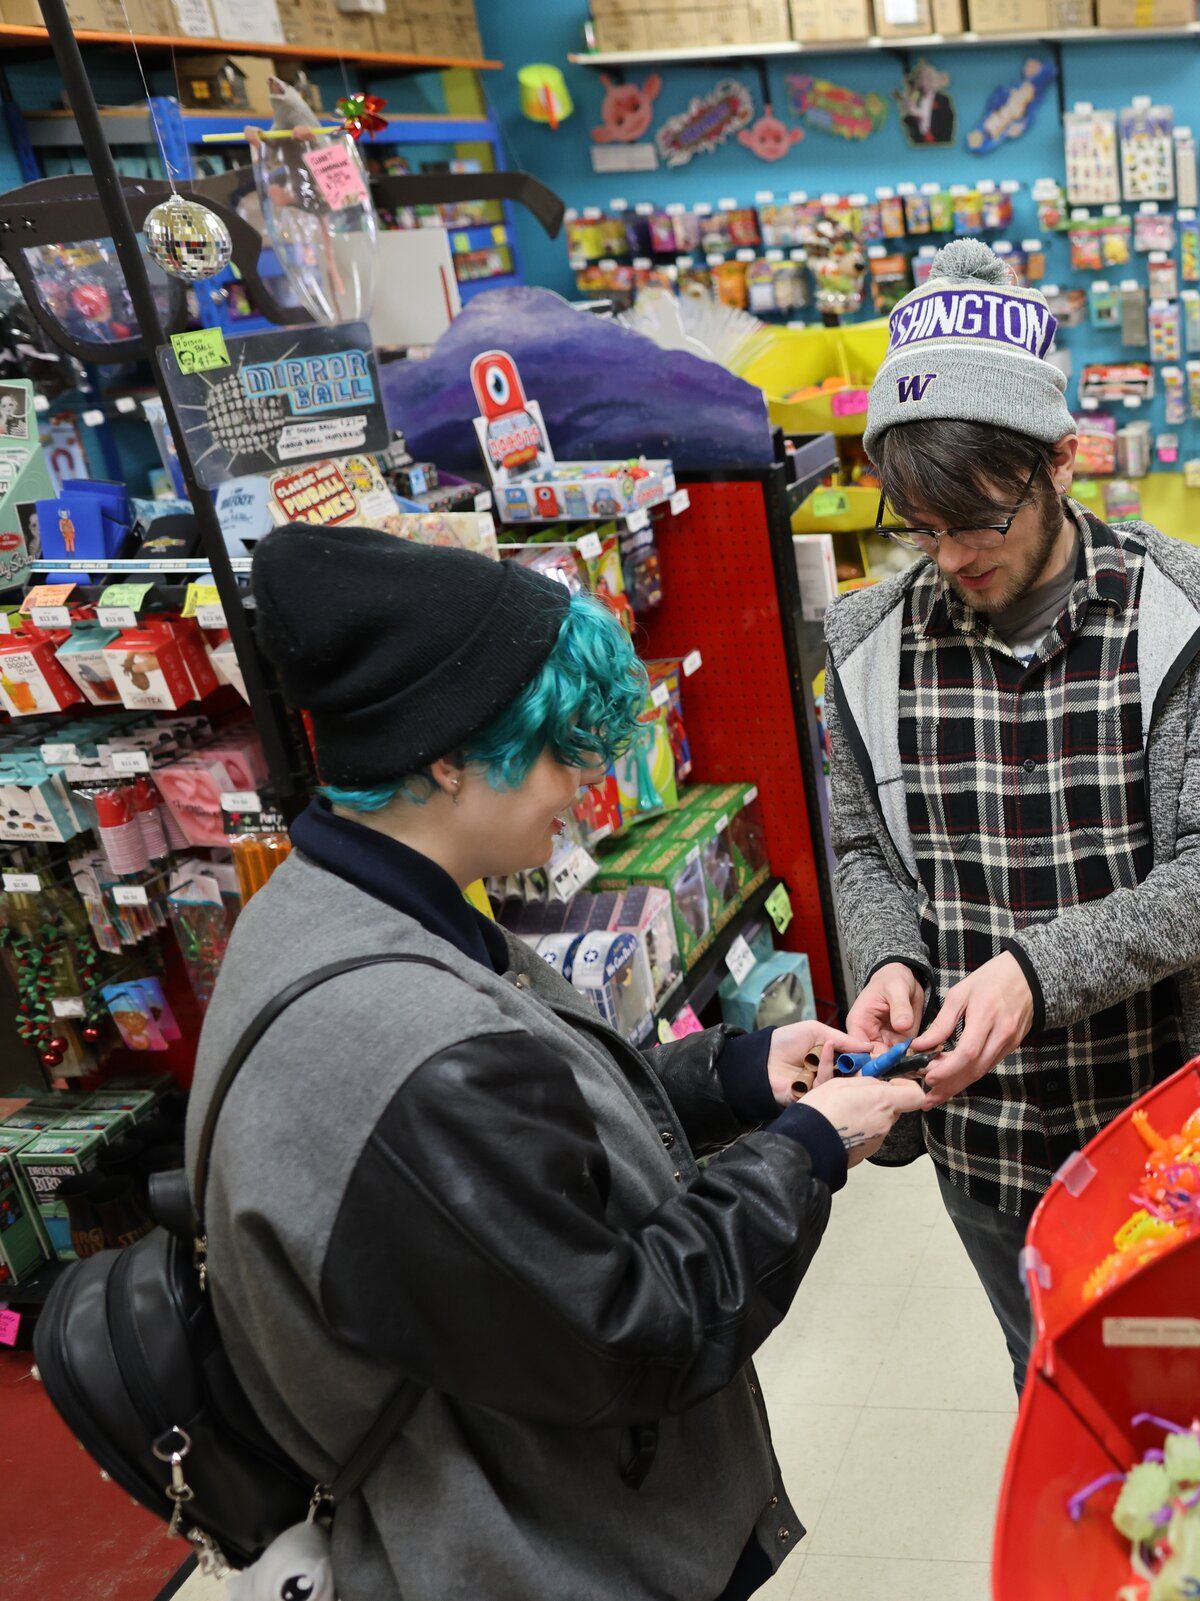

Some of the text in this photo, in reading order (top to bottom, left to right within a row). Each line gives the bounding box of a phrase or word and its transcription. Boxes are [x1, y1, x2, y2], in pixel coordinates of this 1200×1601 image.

[246, 352, 367, 393] MIRROR
[897, 373, 937, 403] W
[293, 377, 373, 409] BALL
[283, 475, 345, 517] PINBALL
[27, 1165, 76, 1177] DRINKING
